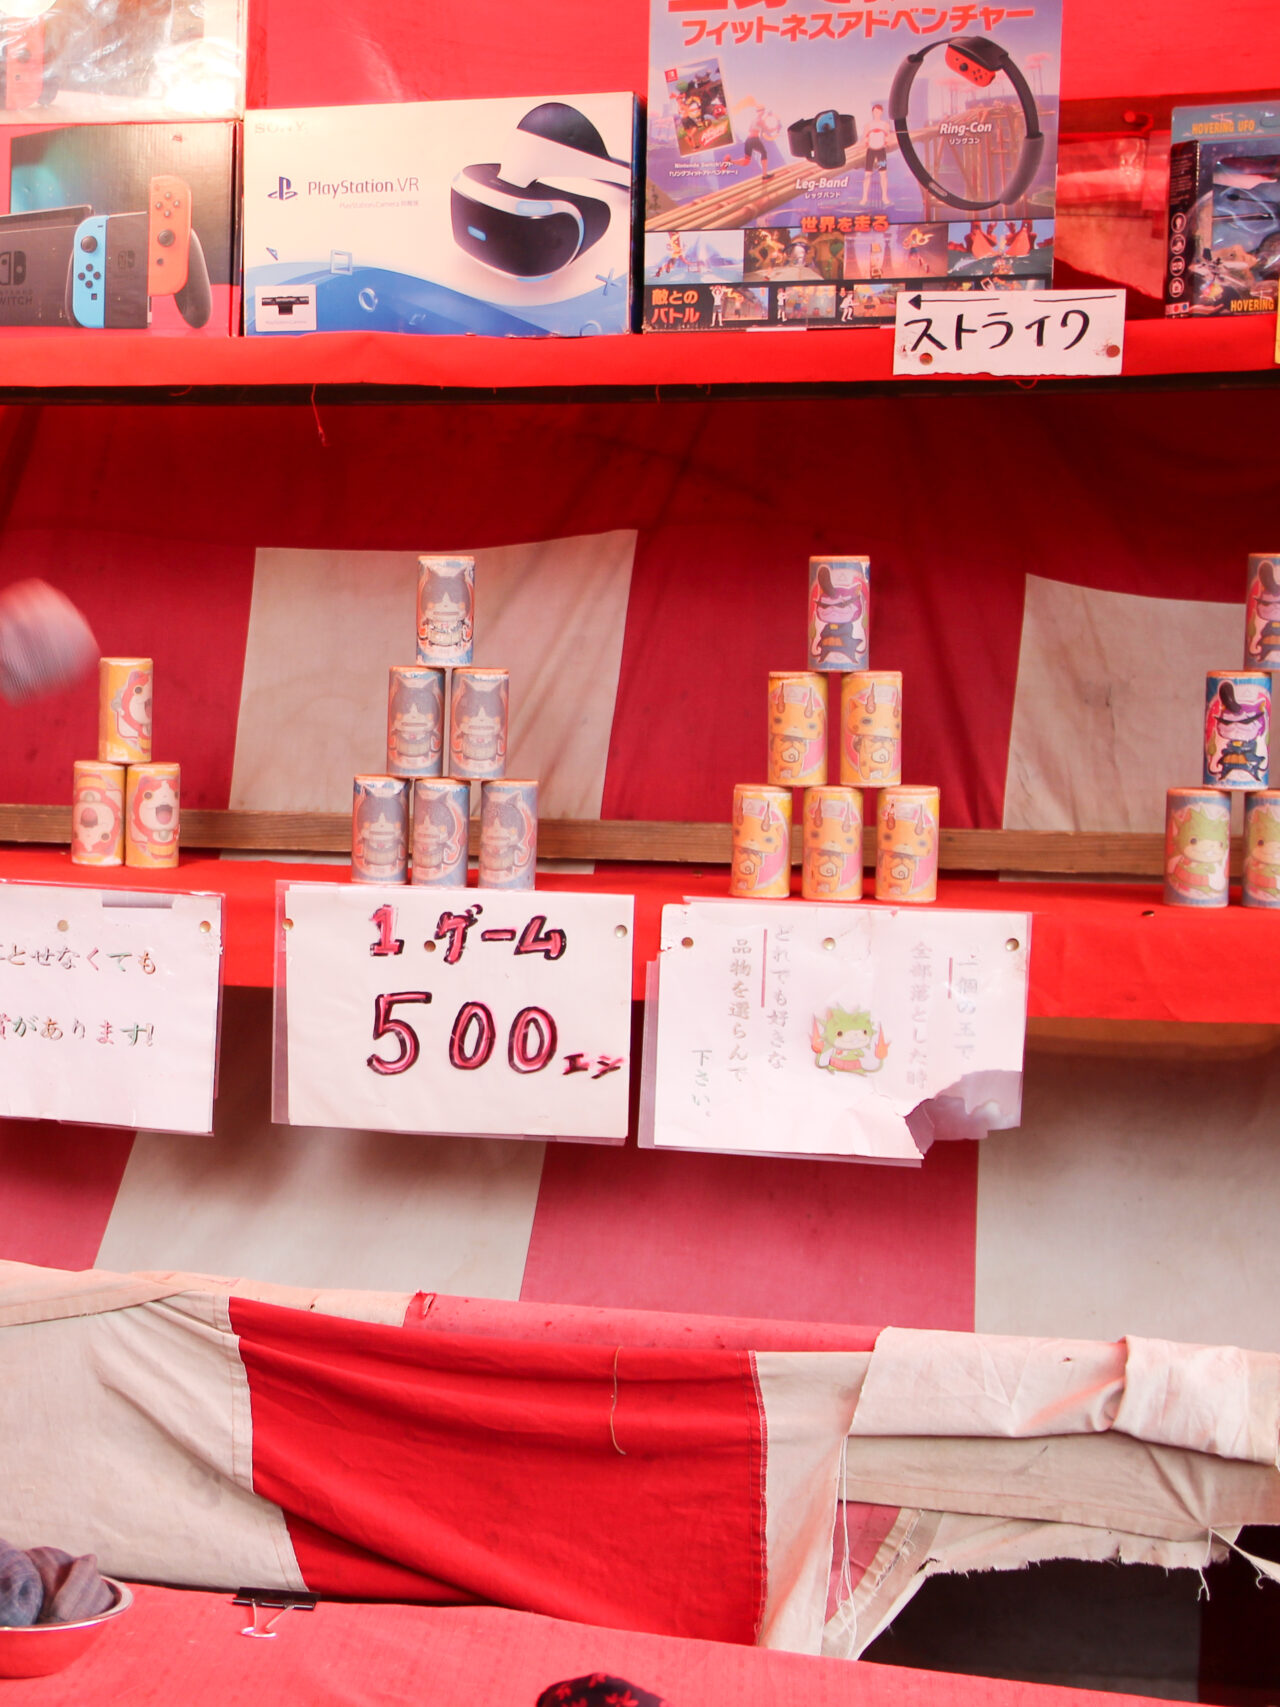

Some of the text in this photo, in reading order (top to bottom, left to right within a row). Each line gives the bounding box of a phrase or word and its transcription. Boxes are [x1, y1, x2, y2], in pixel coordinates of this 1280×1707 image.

[681, 8, 1035, 46] フィットネスアドベンチャー
[940, 122, 992, 136] Ring-Con
[796, 176, 849, 192] Leg-Band
[801, 215, 890, 233] 世界を走る
[651, 288, 699, 306] 敵との
[1230, 299, 1275, 312] HOVERING
[651, 307, 701, 324] バトル
[904, 310, 1090, 352] ストライク
[766, 924, 795, 1071] どれでも好きな
[727, 938, 753, 1083] 品物を選らんで
